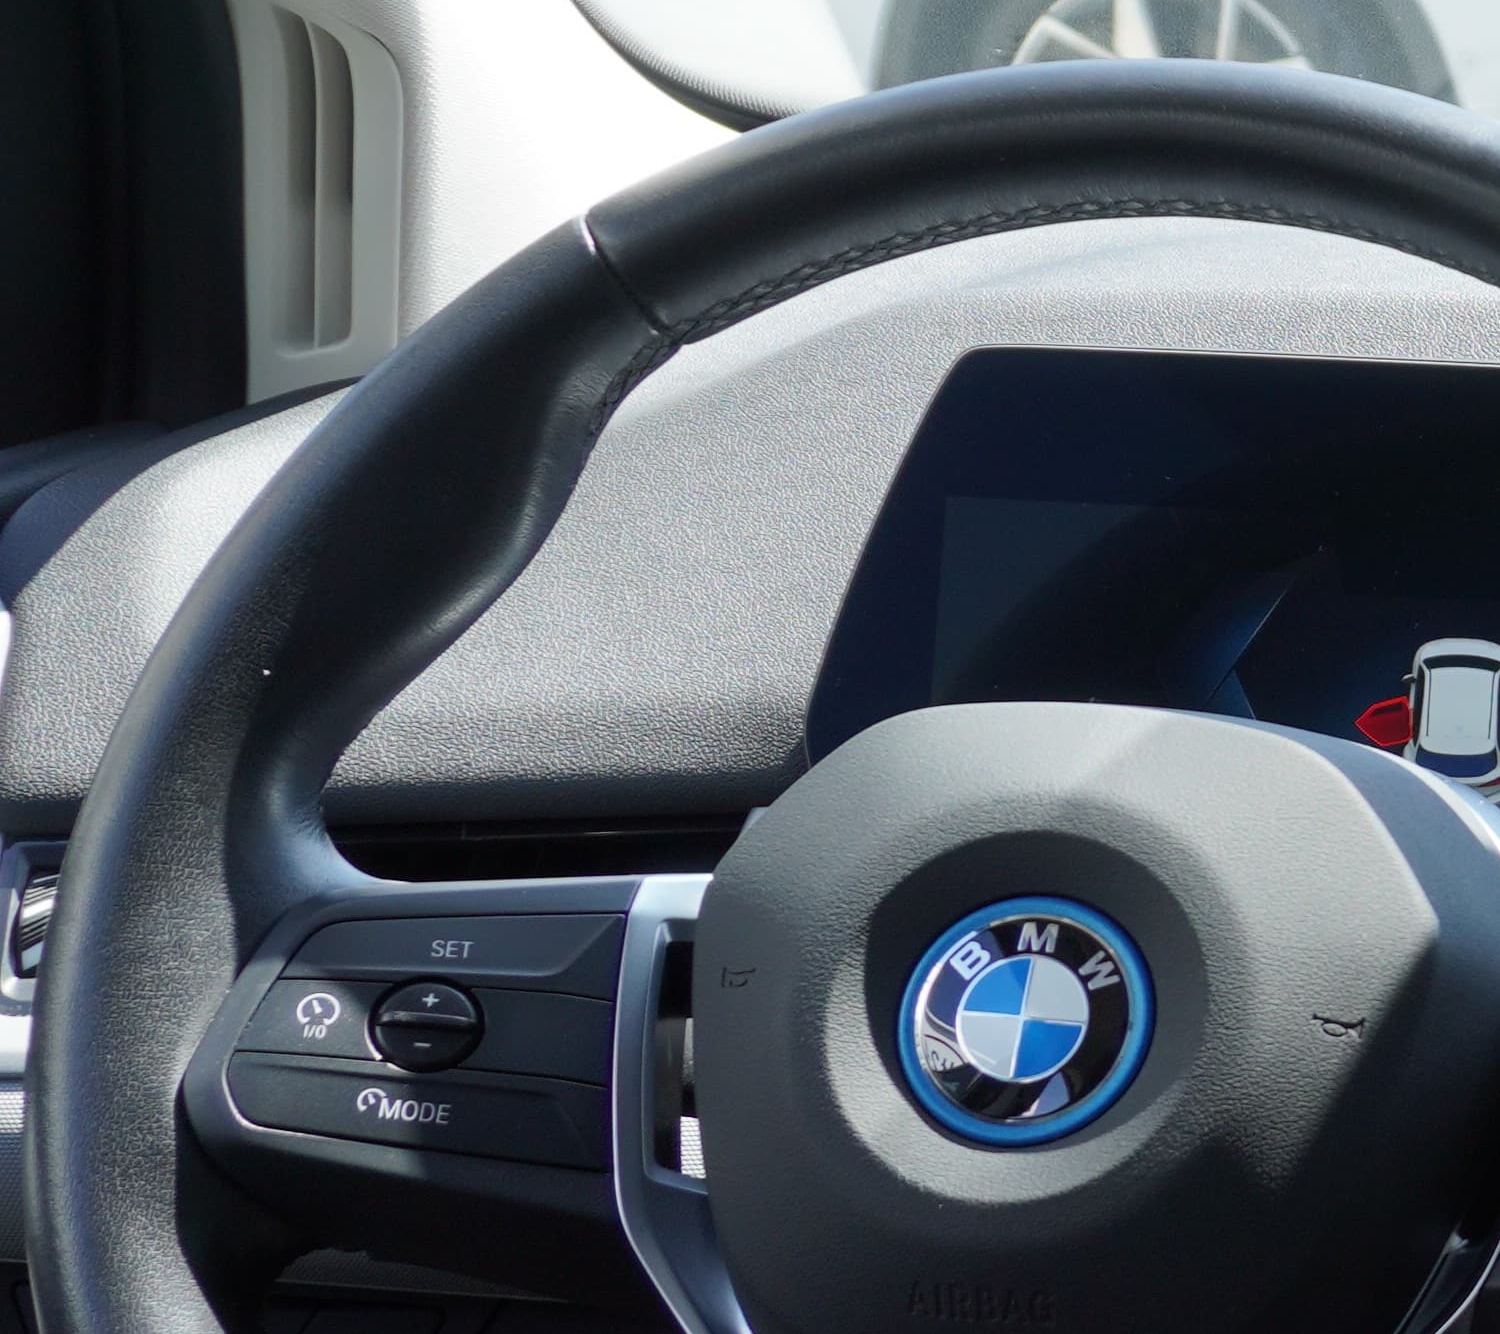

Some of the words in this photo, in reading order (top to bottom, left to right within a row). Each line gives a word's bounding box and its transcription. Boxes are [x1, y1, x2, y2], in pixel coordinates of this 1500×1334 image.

[431, 940, 474, 958] SET
[949, 921, 1121, 992] BMW
[378, 1097, 451, 1125] MODE
